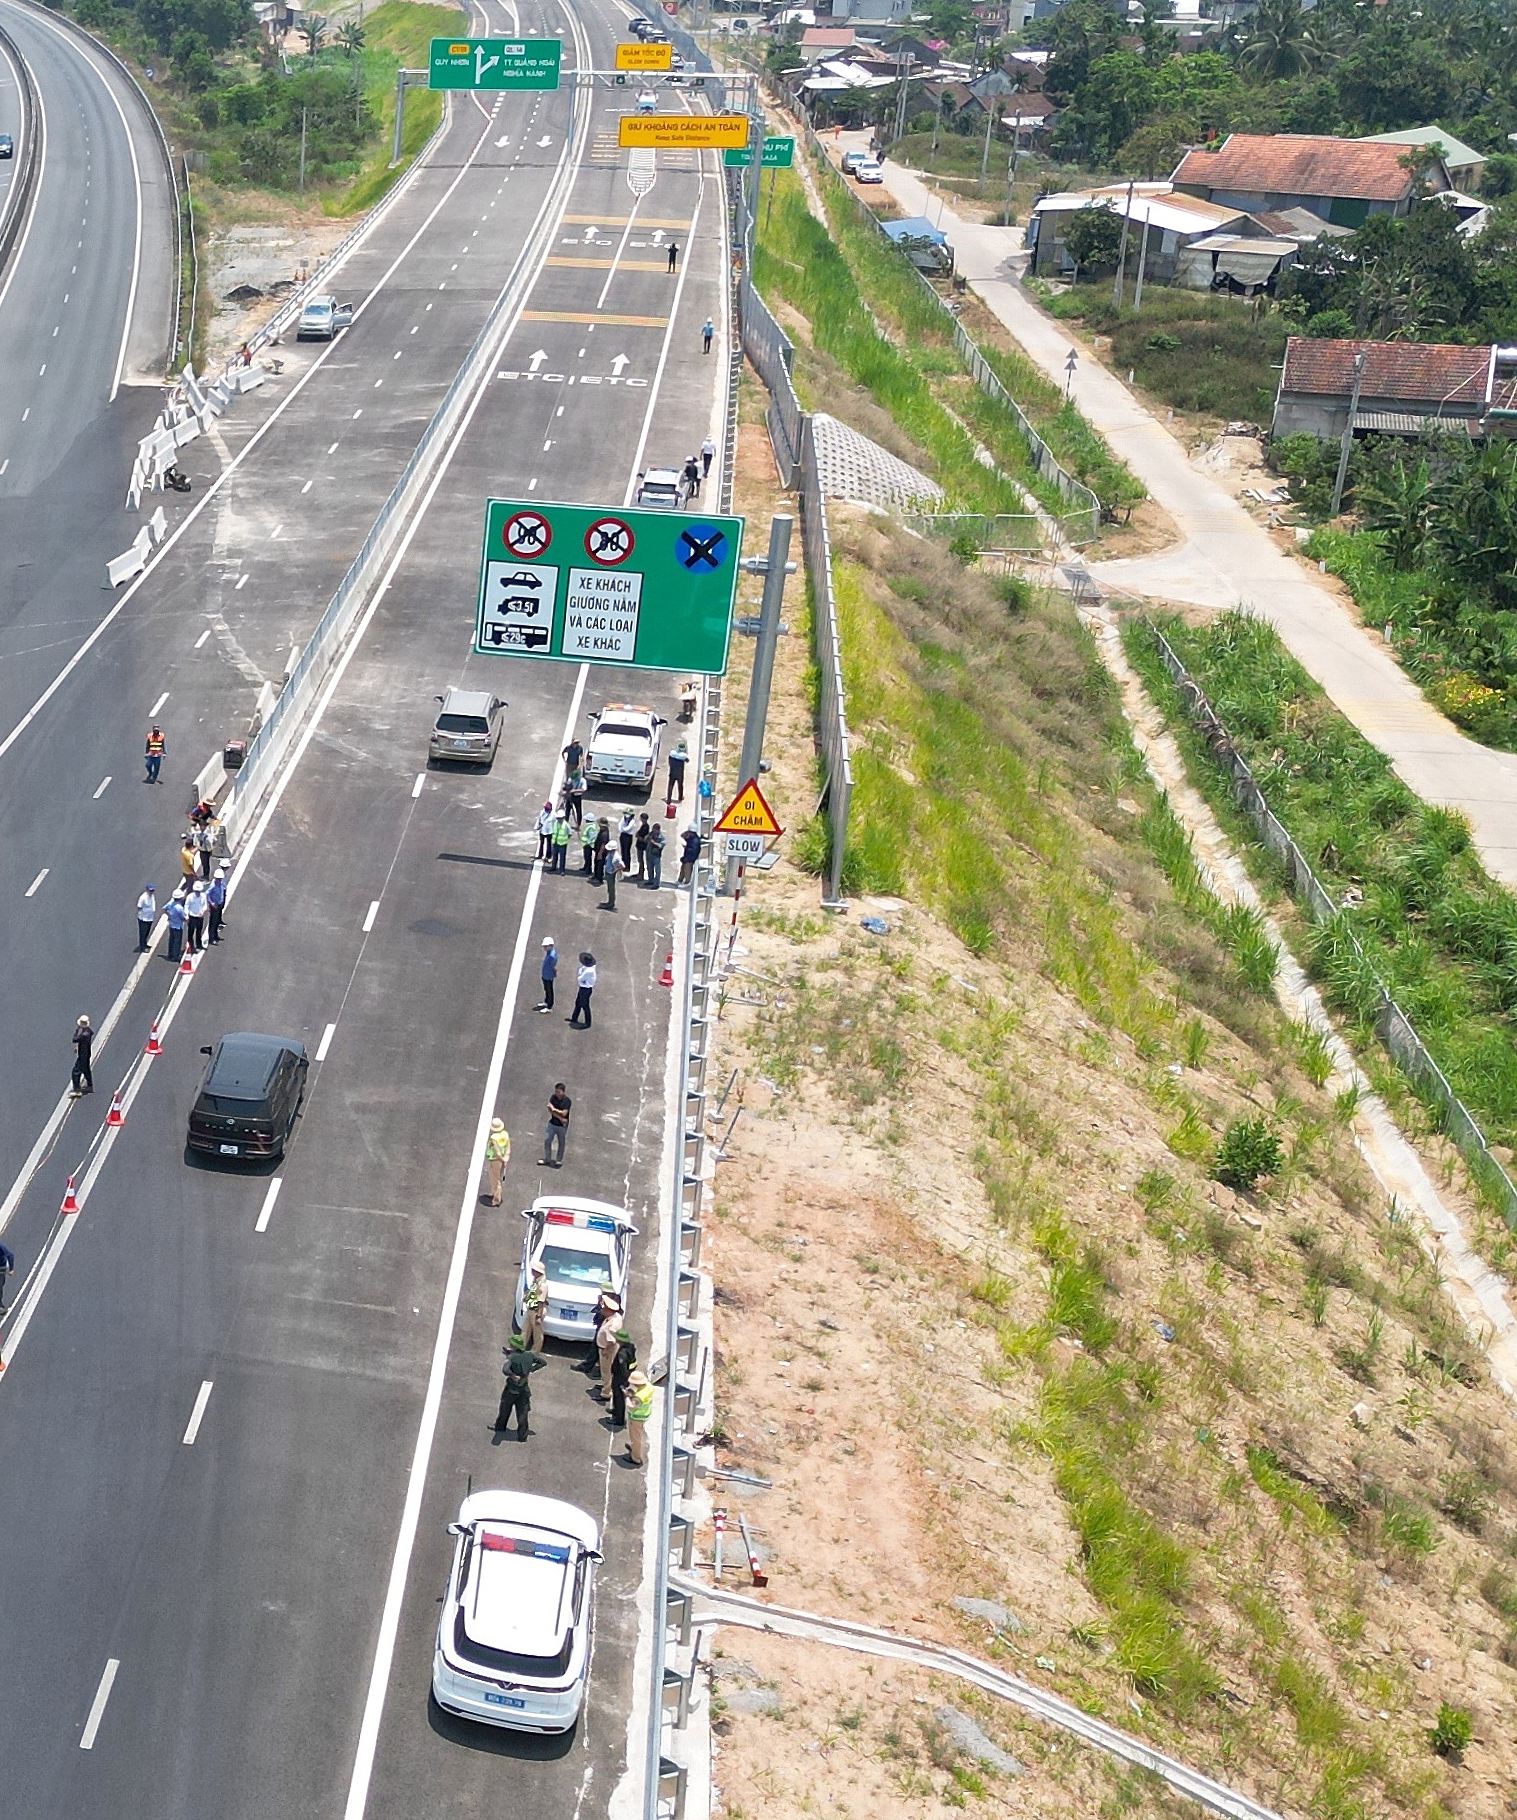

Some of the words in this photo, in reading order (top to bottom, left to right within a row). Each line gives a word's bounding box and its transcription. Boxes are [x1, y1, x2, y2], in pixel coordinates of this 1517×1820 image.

[680, 121, 702, 131] CÁCH
[704, 123, 716, 131] AN
[718, 121, 741, 131] TOÀN
[561, 238, 612, 246] ETC
[497, 371, 565, 382] ETC
[580, 376, 649, 387] ETC
[579, 576, 592, 590] XE
[595, 576, 631, 593] KHÁCH
[569, 613, 583, 628] VÀ
[585, 614, 606, 630] CÁC
[576, 635, 590, 648] XE
[593, 635, 621, 651] KHÁC
[728, 839, 761, 852] SLOW
